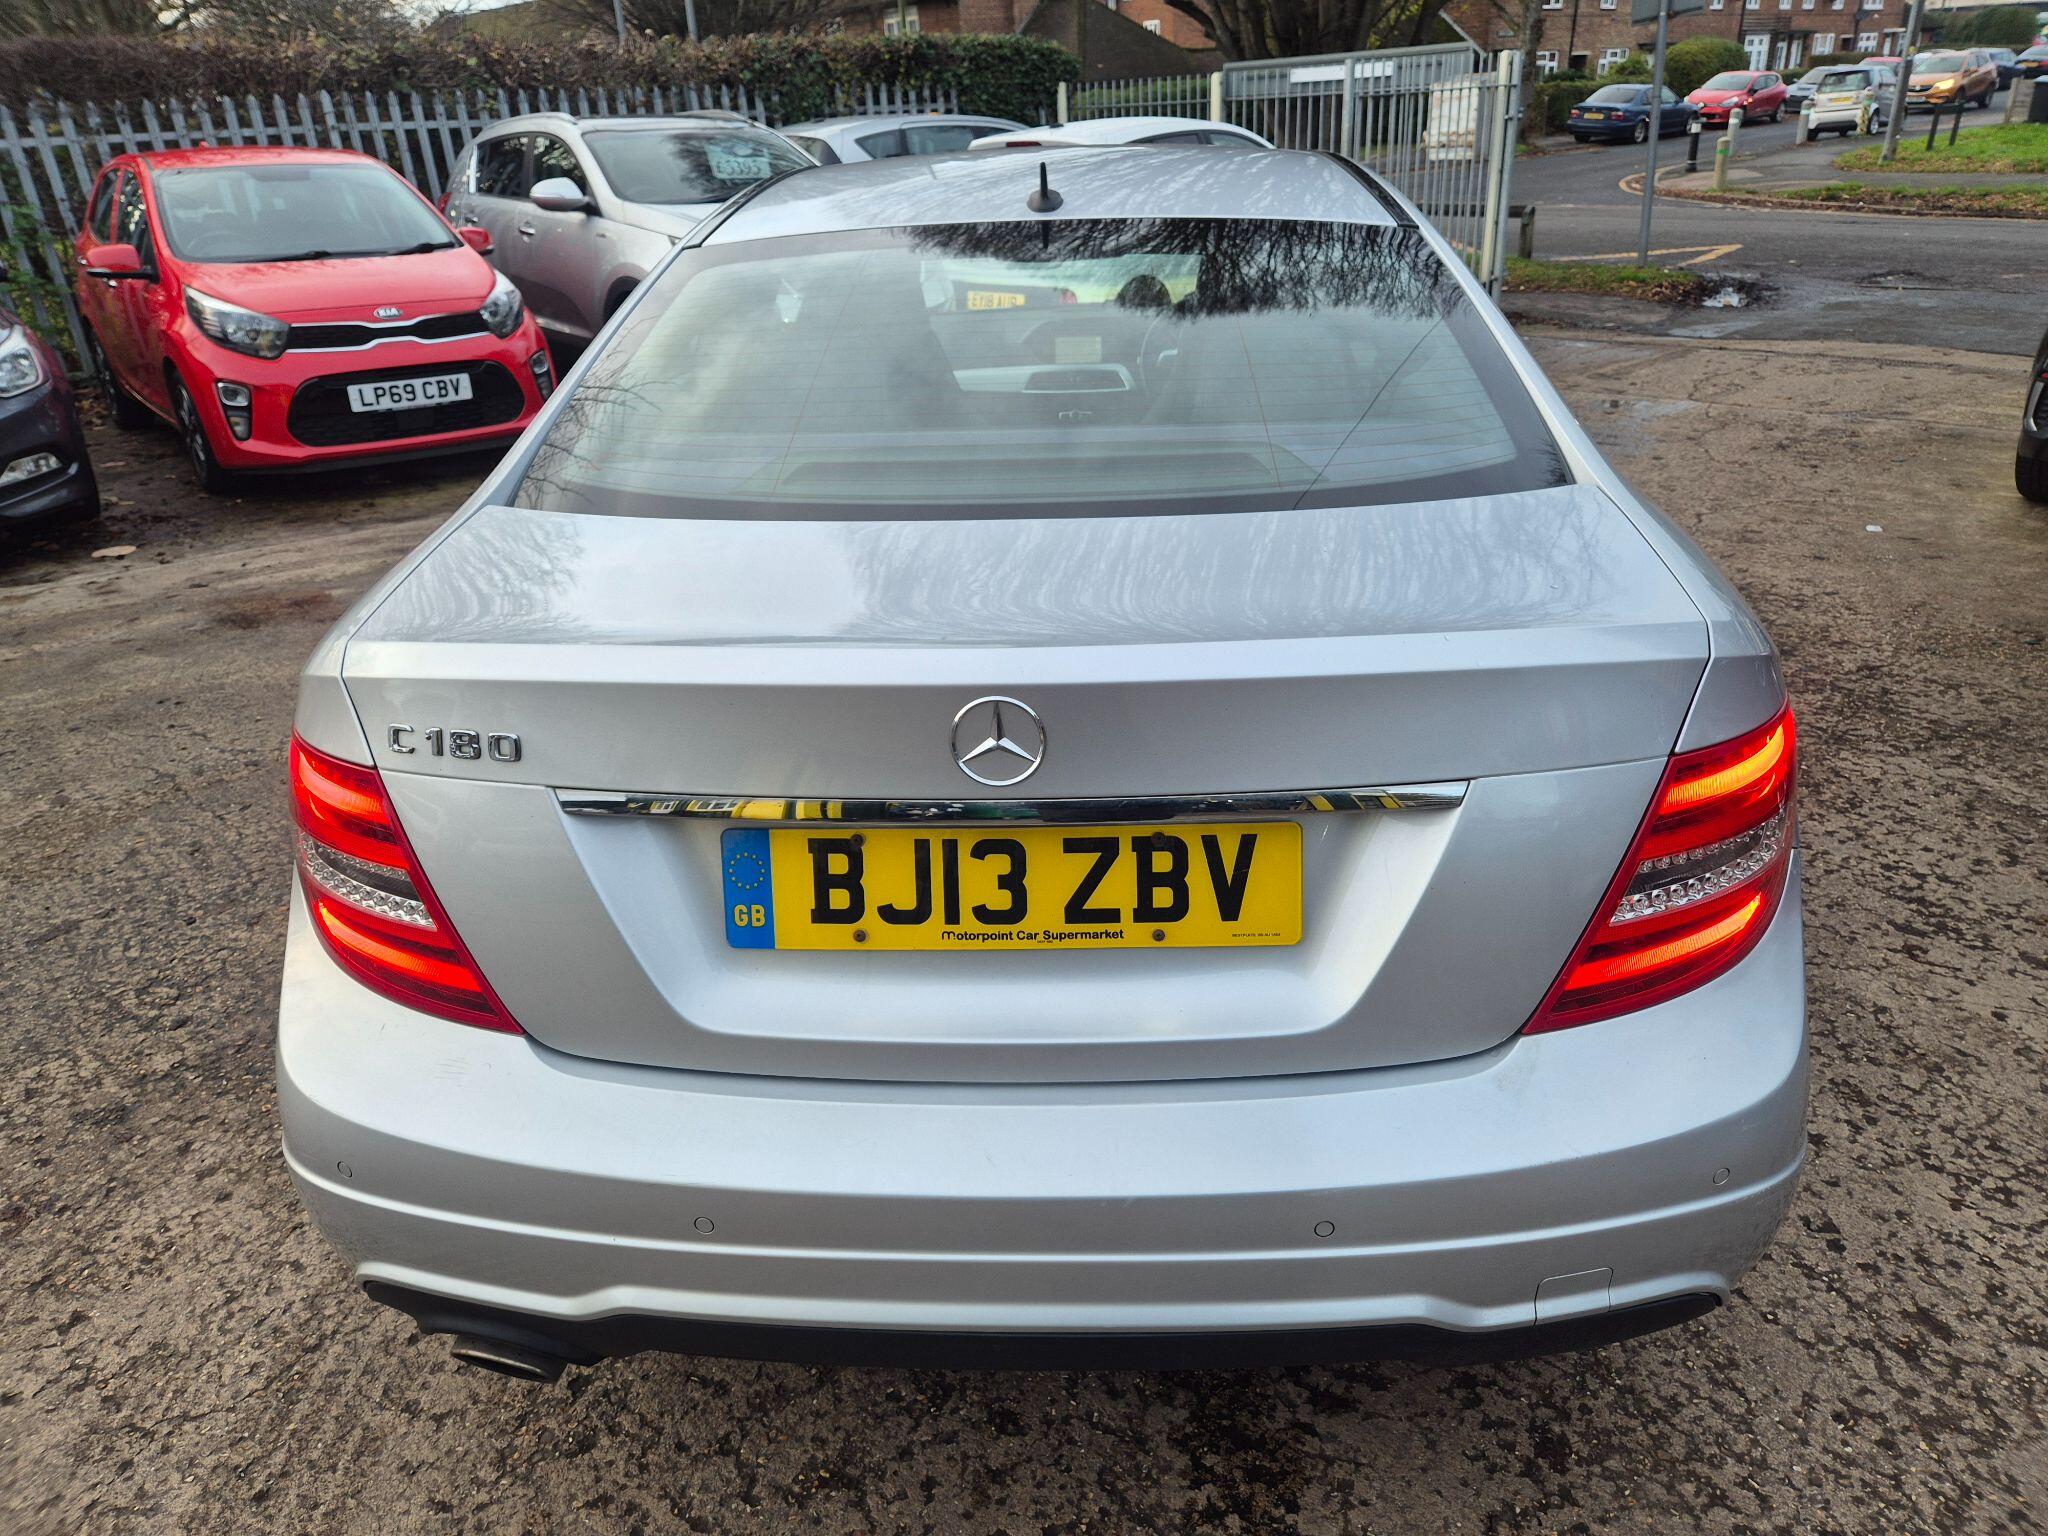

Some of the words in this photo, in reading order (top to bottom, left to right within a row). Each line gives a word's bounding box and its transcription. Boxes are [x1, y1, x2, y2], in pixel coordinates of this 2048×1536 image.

[358, 383, 417, 407] LP69
[421, 377, 461, 401] CBV
[387, 722, 416, 754] C
[424, 726, 523, 763] 180
[806, 836, 1029, 926] BJ13
[1063, 833, 1258, 925] ZBV
[733, 904, 766, 928] GB
[1016, 930, 1040, 941] Car
[1042, 929, 1125, 942] Supermarket
